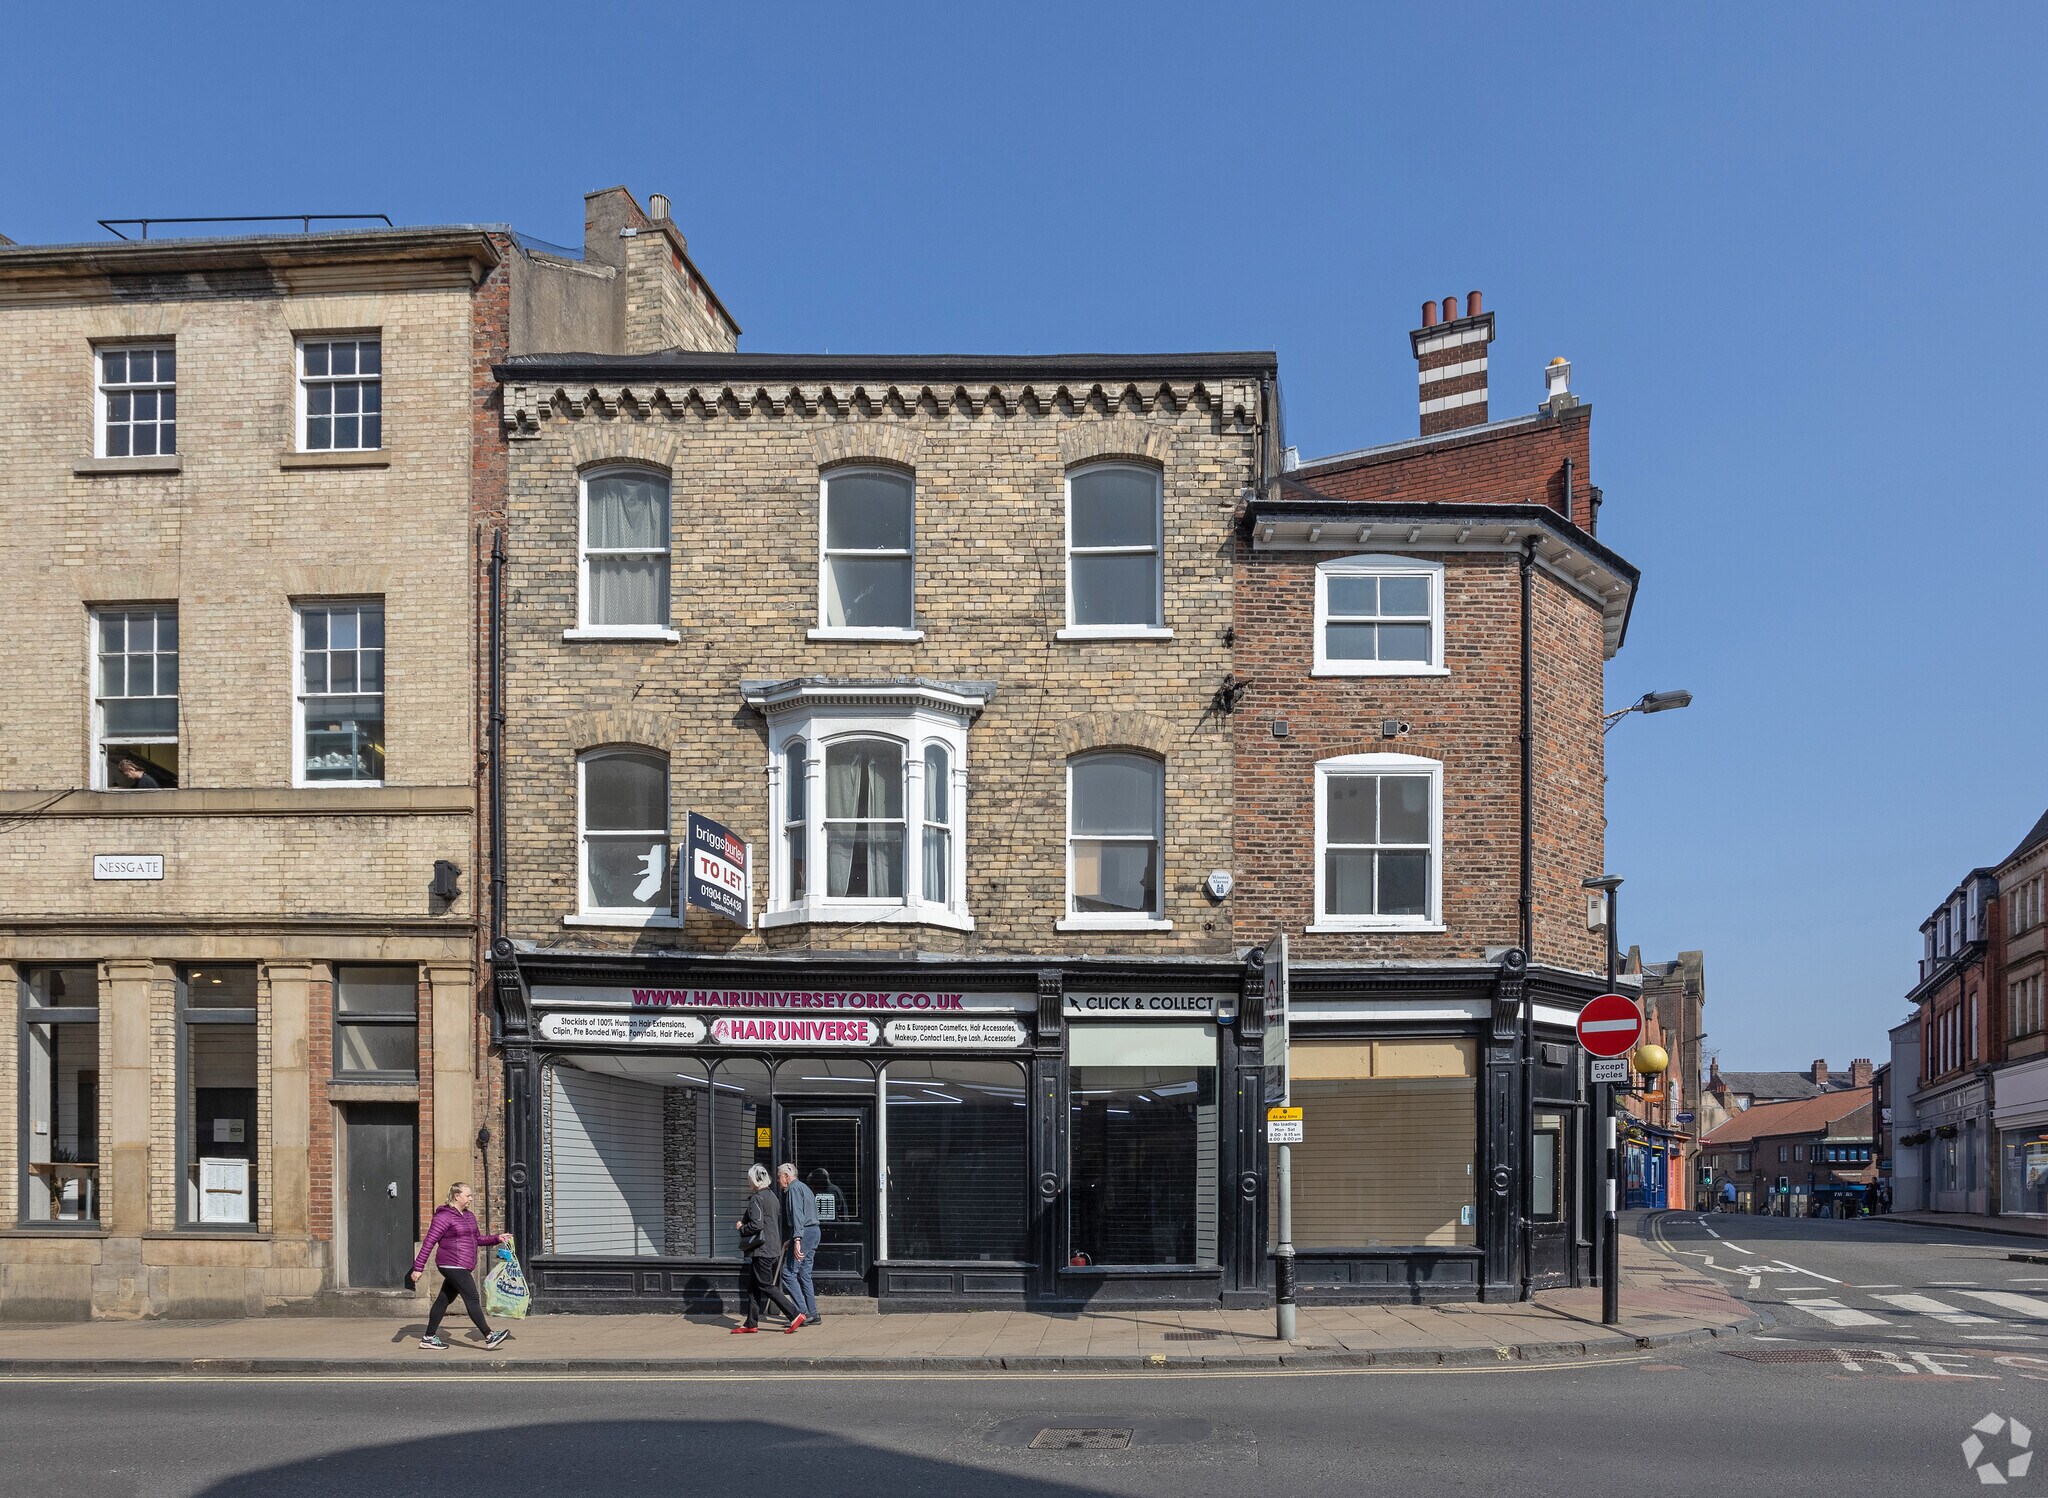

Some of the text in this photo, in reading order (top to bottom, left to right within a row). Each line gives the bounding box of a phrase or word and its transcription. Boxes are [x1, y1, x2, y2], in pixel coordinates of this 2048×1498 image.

[98, 861, 159, 873] NESSGATE
[700, 856, 720, 879] TO
[723, 867, 742, 891] LET
[701, 884, 742, 913] 01904 654438
[631, 989, 964, 1010] WWW.HAIRUNIVERSEYORK.CO.UK
[1086, 996, 1214, 1010] CLICK & COLLECT
[561, 1017, 588, 1026] Stockists
[589, 1018, 596, 1026] of
[597, 1018, 614, 1027] 100%
[615, 1019, 638, 1027] Human
[639, 1019, 651, 1028] Hair
[895, 1023, 906, 1031] Afro
[907, 1023, 912, 1031] &
[912, 1023, 939, 1032] European
[660, 1030, 672, 1038] Hair
[673, 1030, 695, 1038] Pieces
[958, 1034, 968, 1043] Eye
[1594, 1063, 1625, 1071] Except
